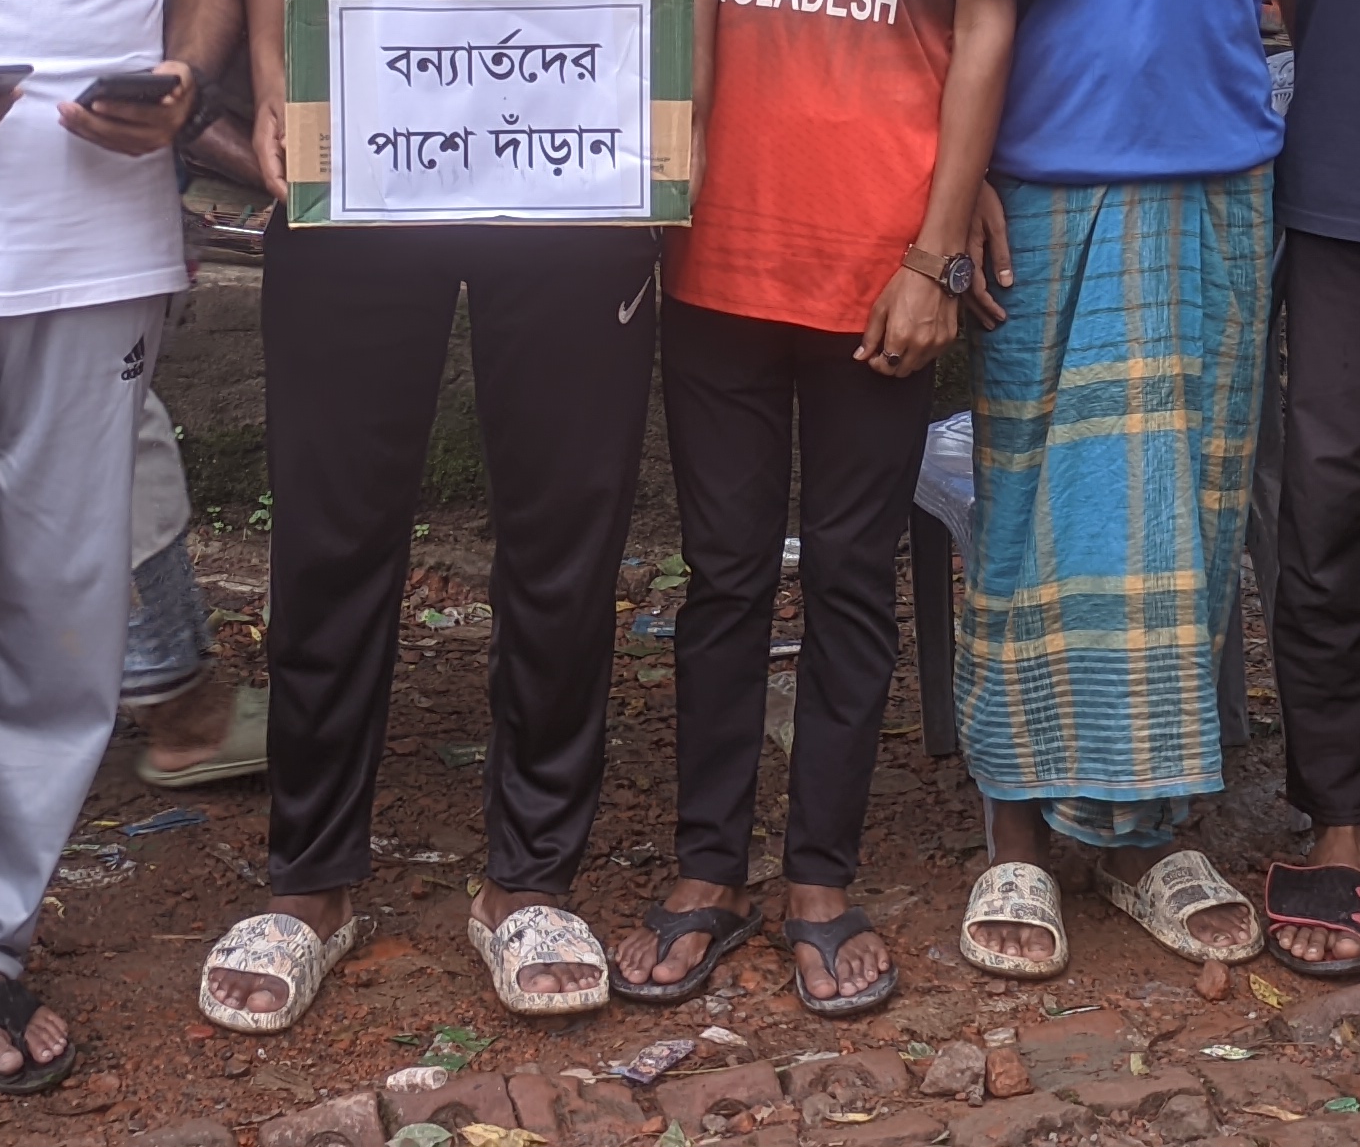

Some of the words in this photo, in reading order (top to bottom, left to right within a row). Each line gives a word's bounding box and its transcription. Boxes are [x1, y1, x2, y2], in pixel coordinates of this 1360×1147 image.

[380, 28, 602, 86] বন্যার্তদের
[367, 125, 476, 172] পাশে
[487, 112, 623, 177] দাঁড়ান
